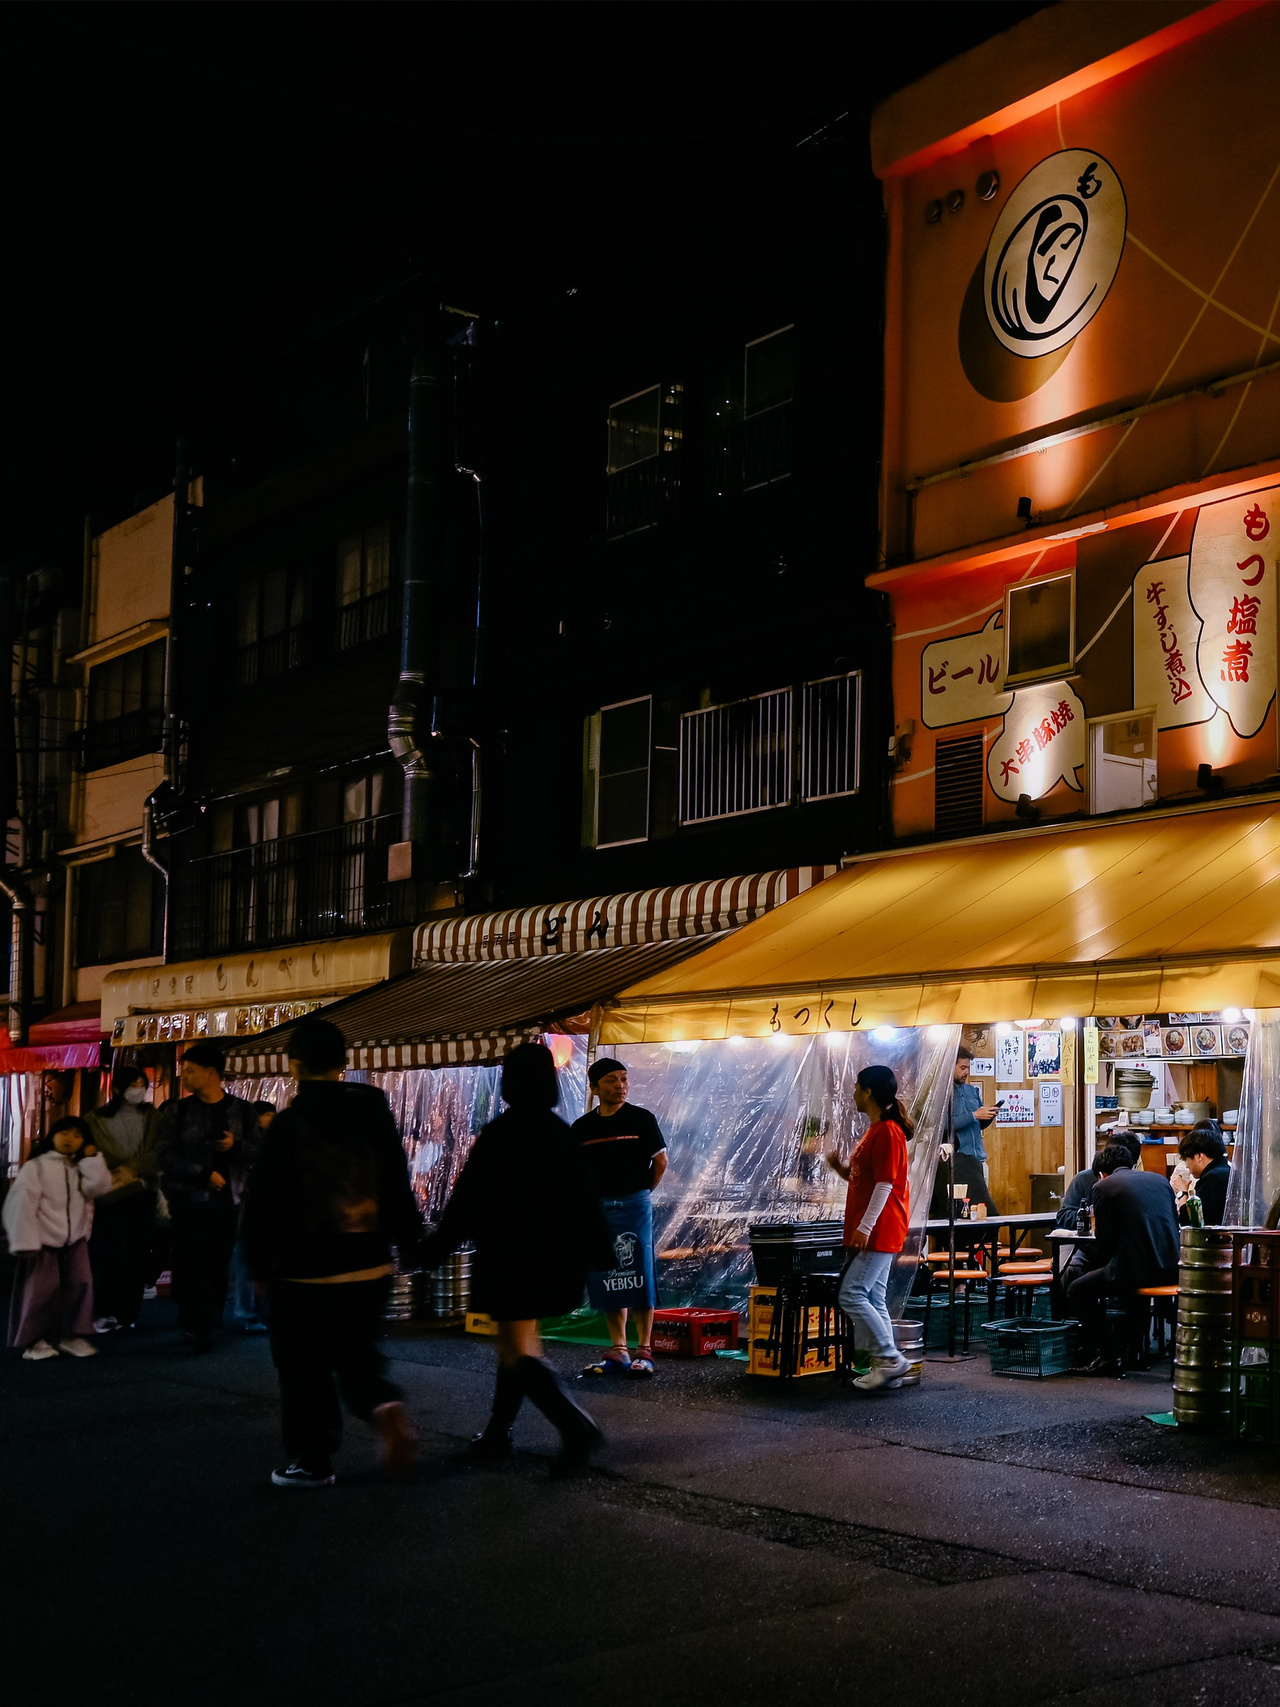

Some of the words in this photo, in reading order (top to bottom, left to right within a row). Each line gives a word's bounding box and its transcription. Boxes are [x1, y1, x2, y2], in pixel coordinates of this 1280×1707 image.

[1220, 502, 1271, 684] もつ塩煮
[1146, 581, 1193, 706] 牛すじ煮込
[928, 653, 1000, 695] ビール
[769, 997, 863, 1033] もつくし
[603, 1275, 644, 1292] YEBISU
